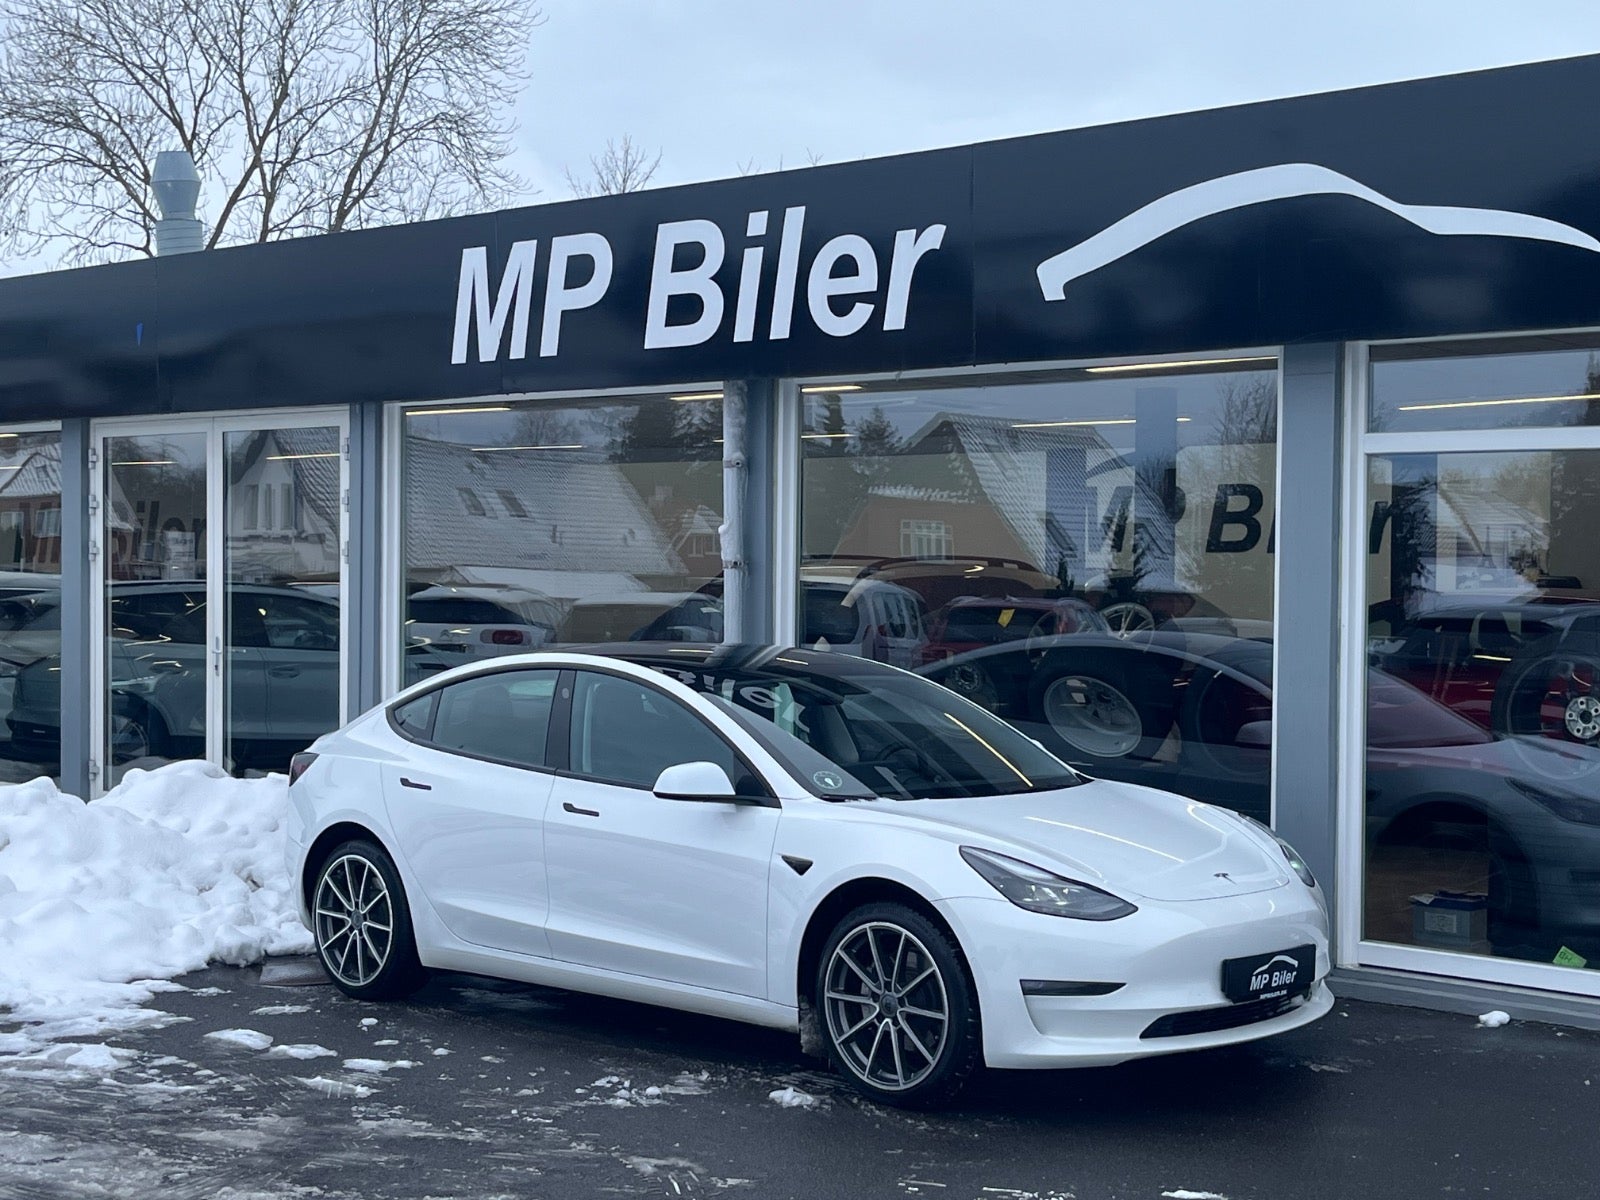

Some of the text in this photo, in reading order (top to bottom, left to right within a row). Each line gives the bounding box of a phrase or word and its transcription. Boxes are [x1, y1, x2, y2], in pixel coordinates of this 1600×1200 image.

[451, 205, 947, 364] MP Biler
[1250, 970, 1296, 991] MP Biler
